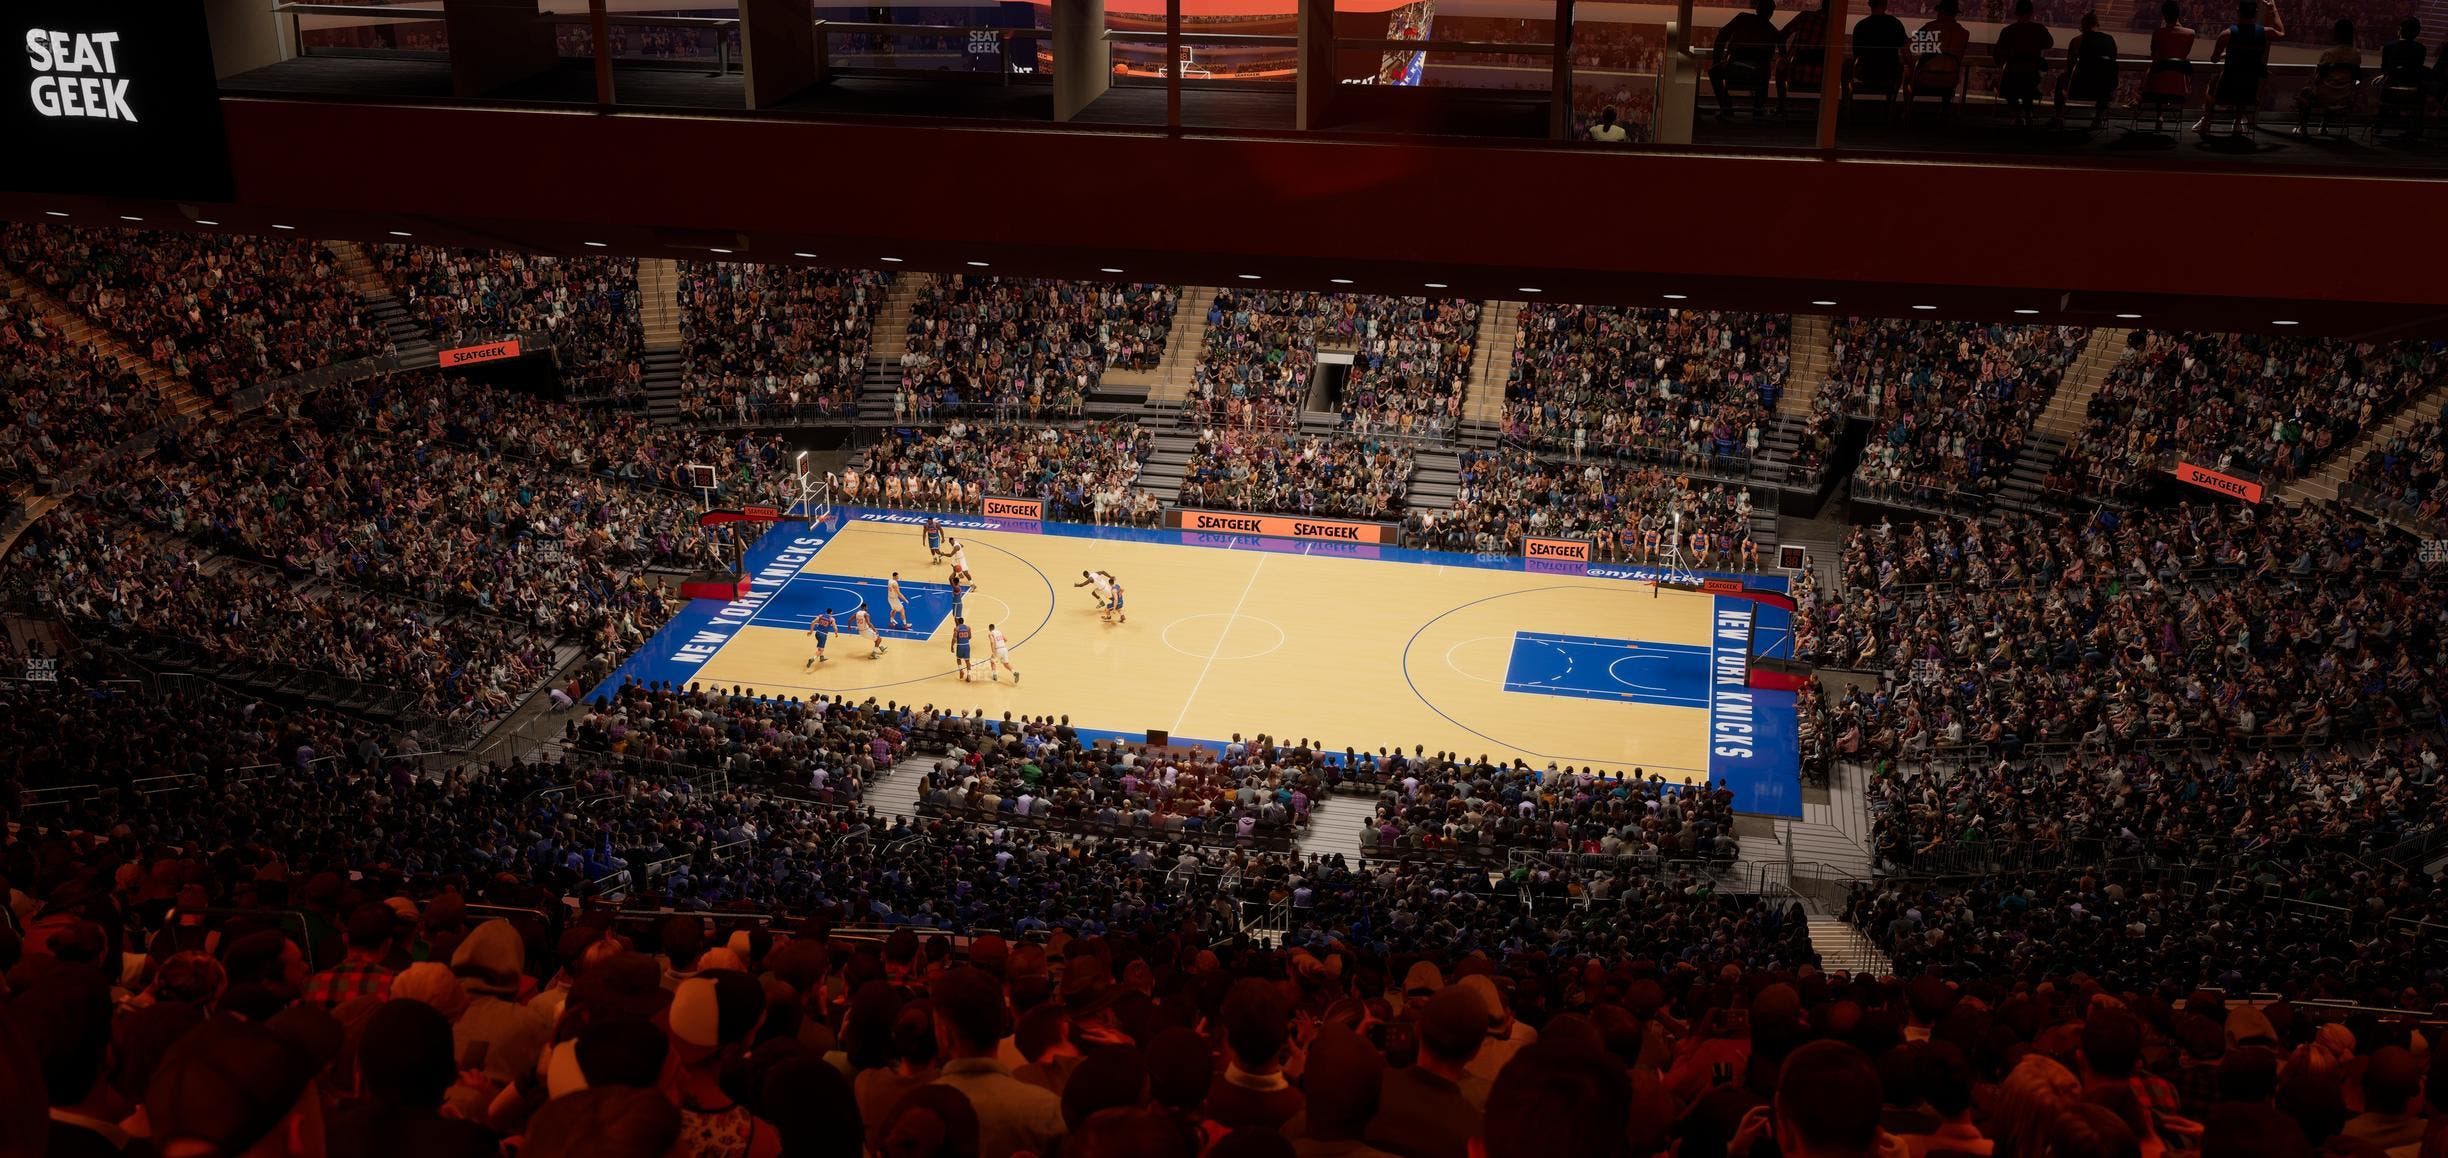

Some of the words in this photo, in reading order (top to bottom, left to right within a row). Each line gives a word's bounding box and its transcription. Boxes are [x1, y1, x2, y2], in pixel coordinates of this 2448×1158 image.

[26, 28, 120, 73] SEAT
[30, 75, 138, 122] GEEK
[453, 346, 506, 363] SEATGEEK
[2191, 470, 2247, 497] SEATGEEK
[988, 502, 1038, 517] SEATGEEK
[1197, 515, 1261, 533] SEATGEEK
[1294, 523, 1359, 540] SEATGEEK
[1529, 542, 1585, 558] SEATGEEK
[670, 630, 729, 663] NEW
[708, 591, 772, 625] YORK
[751, 537, 824, 586] KNICKS
[1718, 610, 1751, 641] NEW
[1717, 647, 1747, 686] YORK
[1715, 691, 1753, 758] KNICKS
